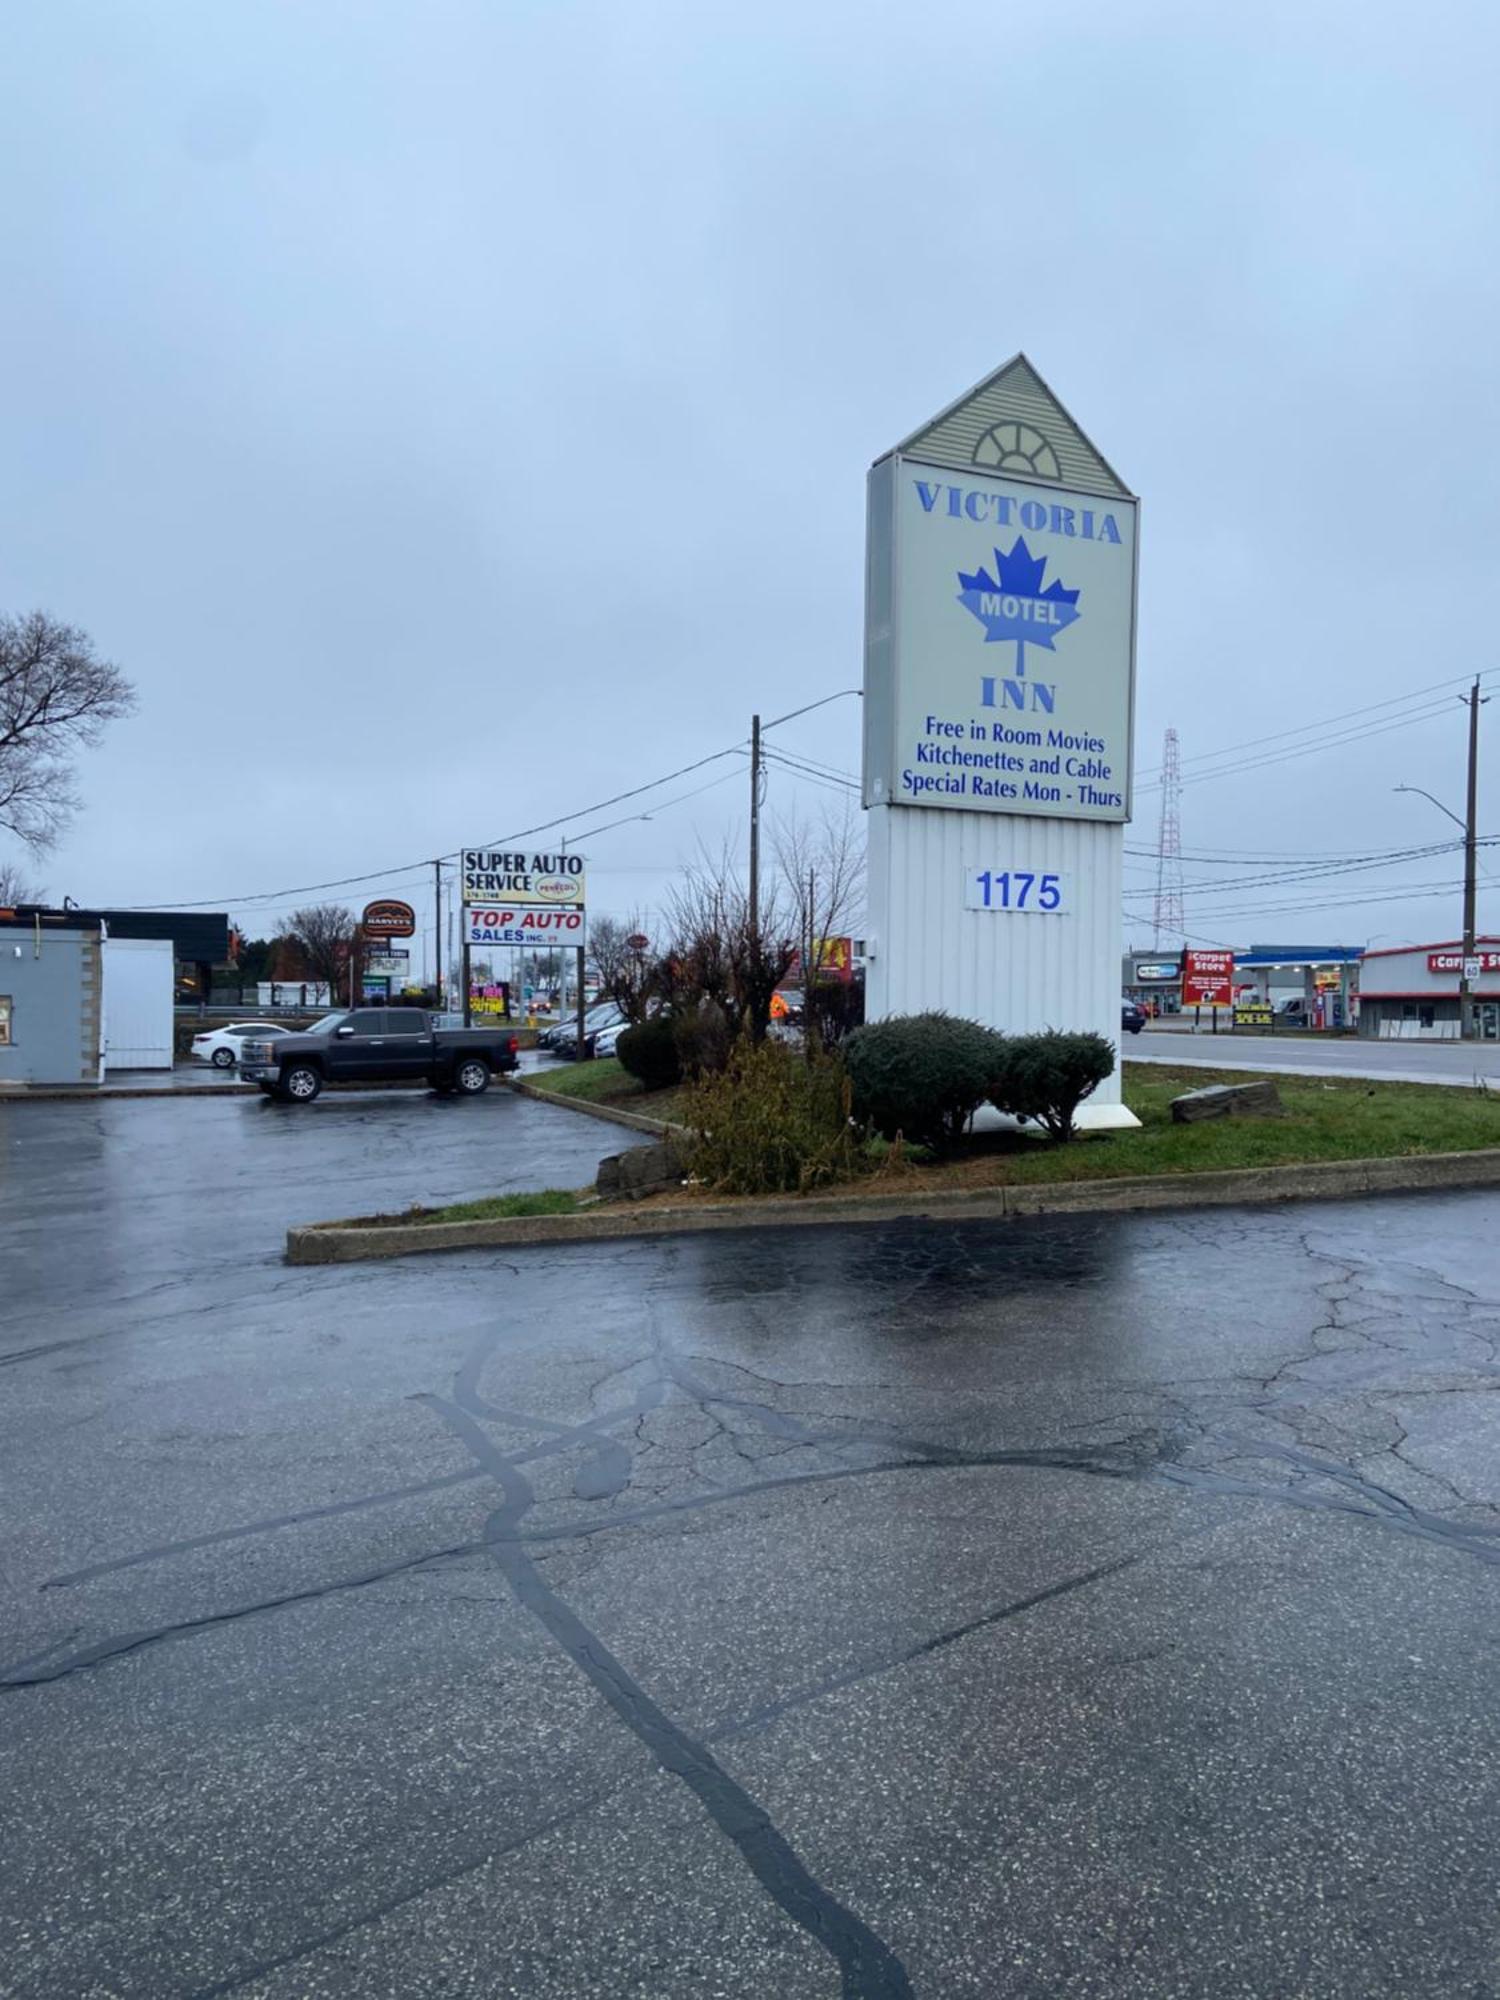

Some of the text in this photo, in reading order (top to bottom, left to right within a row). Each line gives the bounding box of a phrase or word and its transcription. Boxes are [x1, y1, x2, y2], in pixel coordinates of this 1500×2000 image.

[913, 480, 1122, 544] VICTORIA
[980, 591, 1061, 625] MOTEL
[981, 676, 1057, 714] INN
[926, 716, 1106, 753] Free in Room Movies
[916, 744, 1112, 780] Kitchenettes and Cable
[902, 769, 966, 796] Special
[971, 775, 1018, 799] Rates
[1023, 780, 1061, 802] Mon
[1078, 784, 1122, 807] Thurs
[465, 852, 583, 875] SUPER AUTO
[465, 873, 532, 891] SERVICE
[976, 871, 1060, 909] 1175
[470, 911, 581, 929] TOP AUTO
[471, 928, 524, 941] SALES
[1194, 961, 1226, 971] Store
